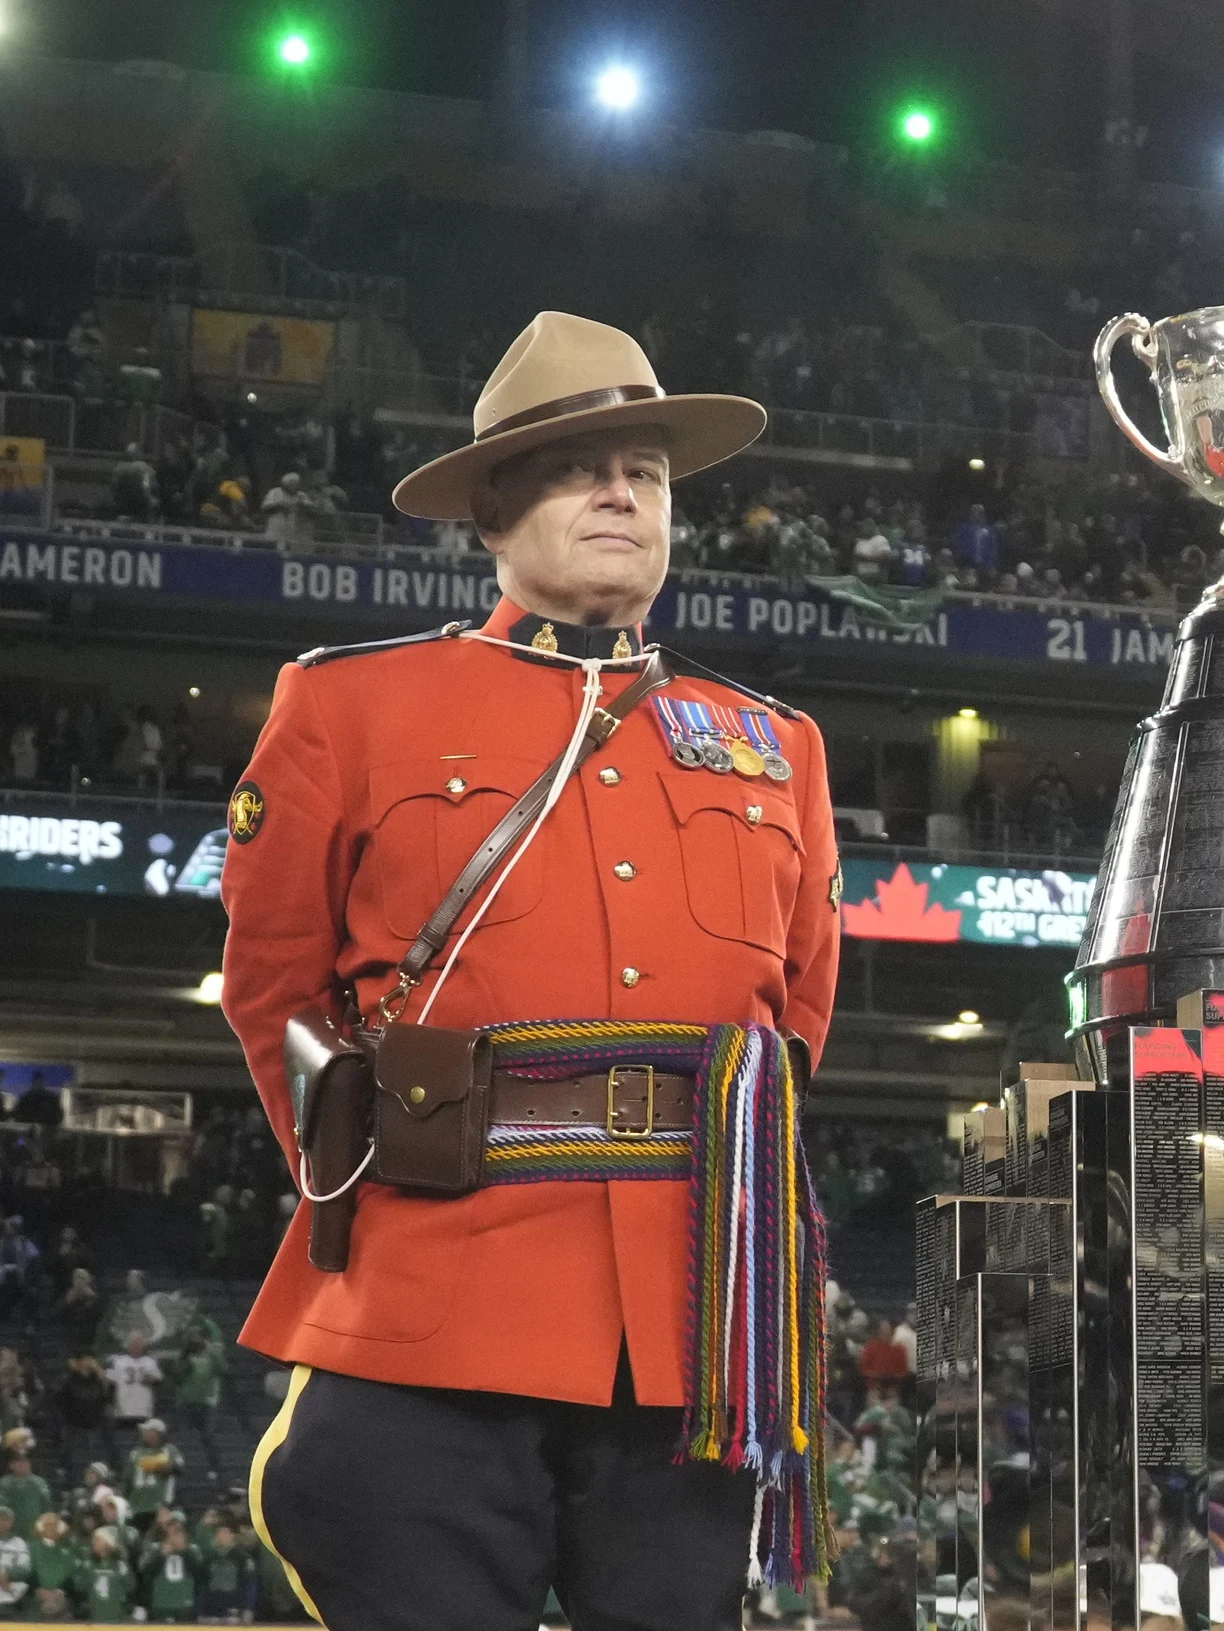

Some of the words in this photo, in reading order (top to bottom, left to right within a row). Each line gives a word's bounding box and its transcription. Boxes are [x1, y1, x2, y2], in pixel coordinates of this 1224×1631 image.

[0, 541, 162, 588] AMERON
[282, 562, 357, 601] BOB
[373, 568, 499, 611] IRVING
[675, 591, 735, 630] JOE
[749, 596, 948, 646] POPLAKI
[1047, 618, 1087, 661] 21
